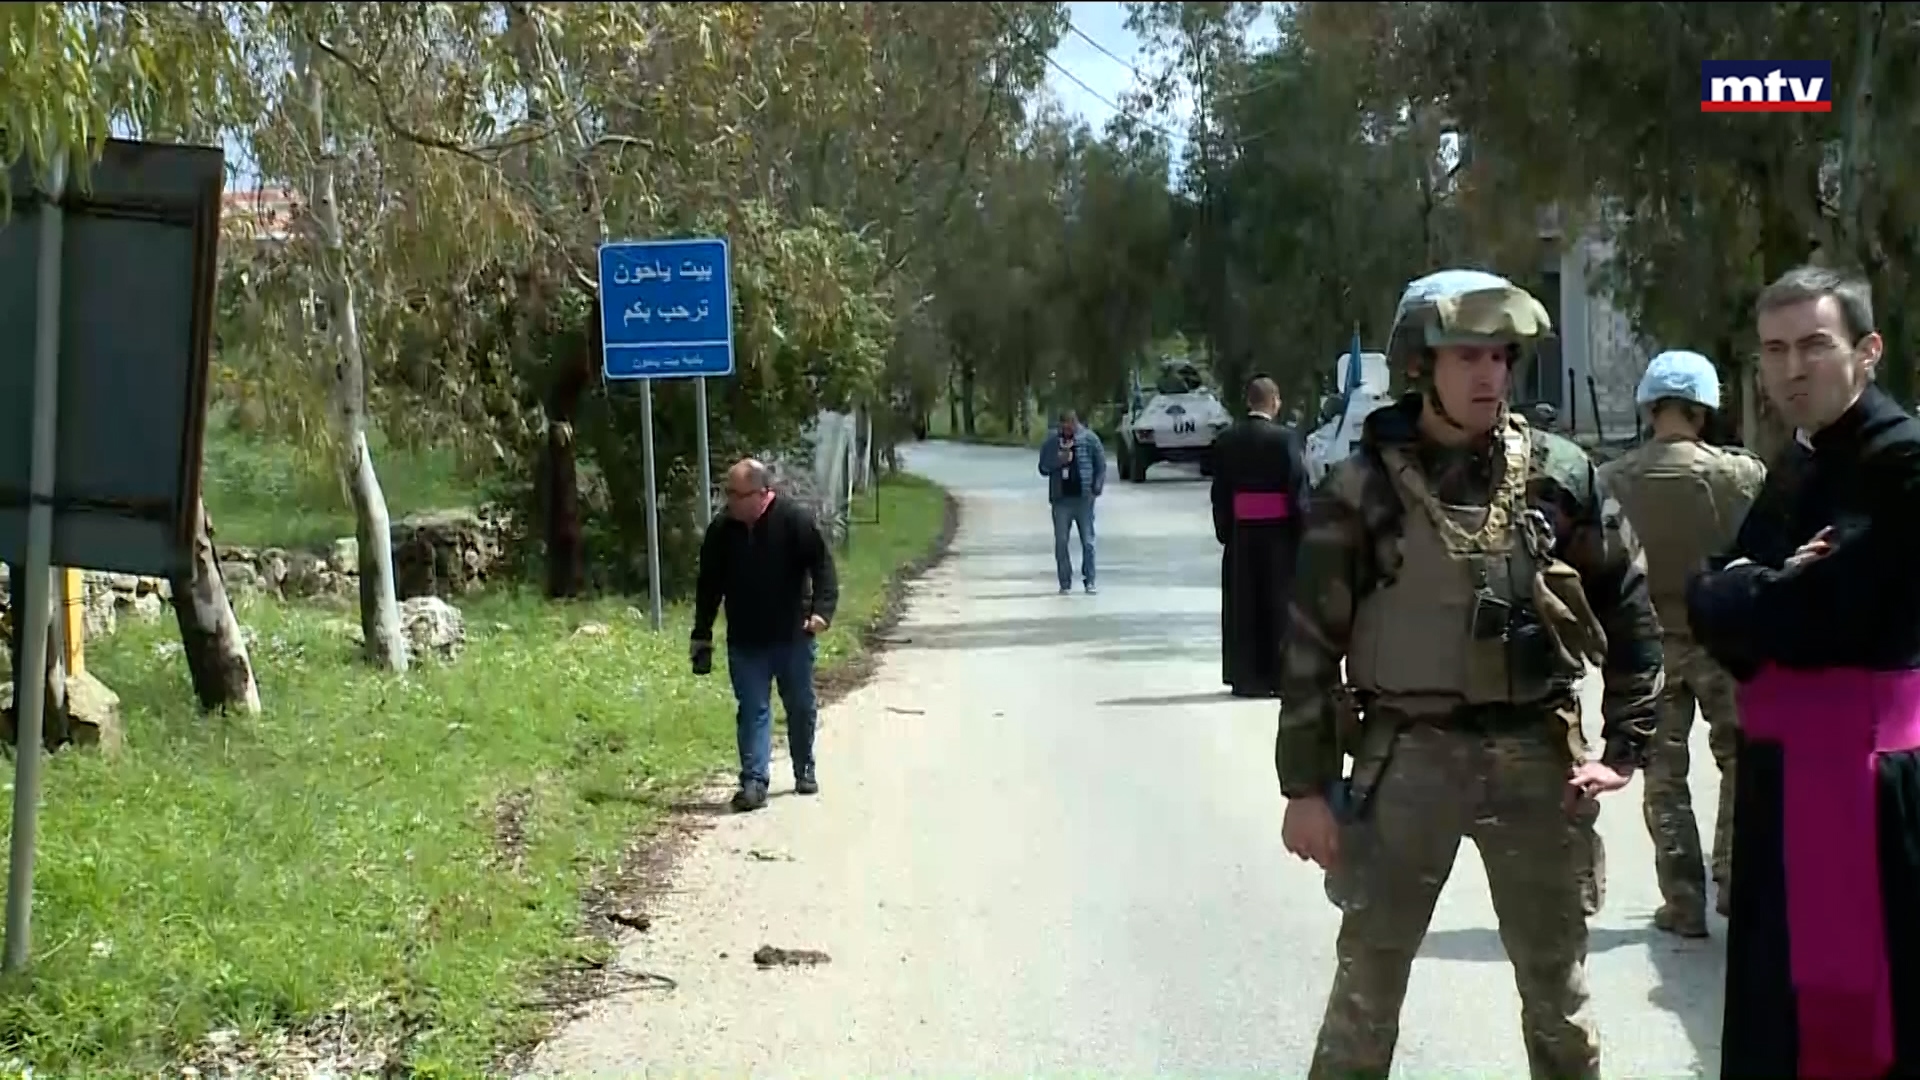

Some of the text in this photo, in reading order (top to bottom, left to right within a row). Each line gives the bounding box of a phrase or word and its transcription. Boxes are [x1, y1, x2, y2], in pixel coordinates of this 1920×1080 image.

[613, 260, 712, 284] بيت ياحون
[624, 299, 709, 327] ترحب بكم
[1173, 421, 1196, 434] UN
